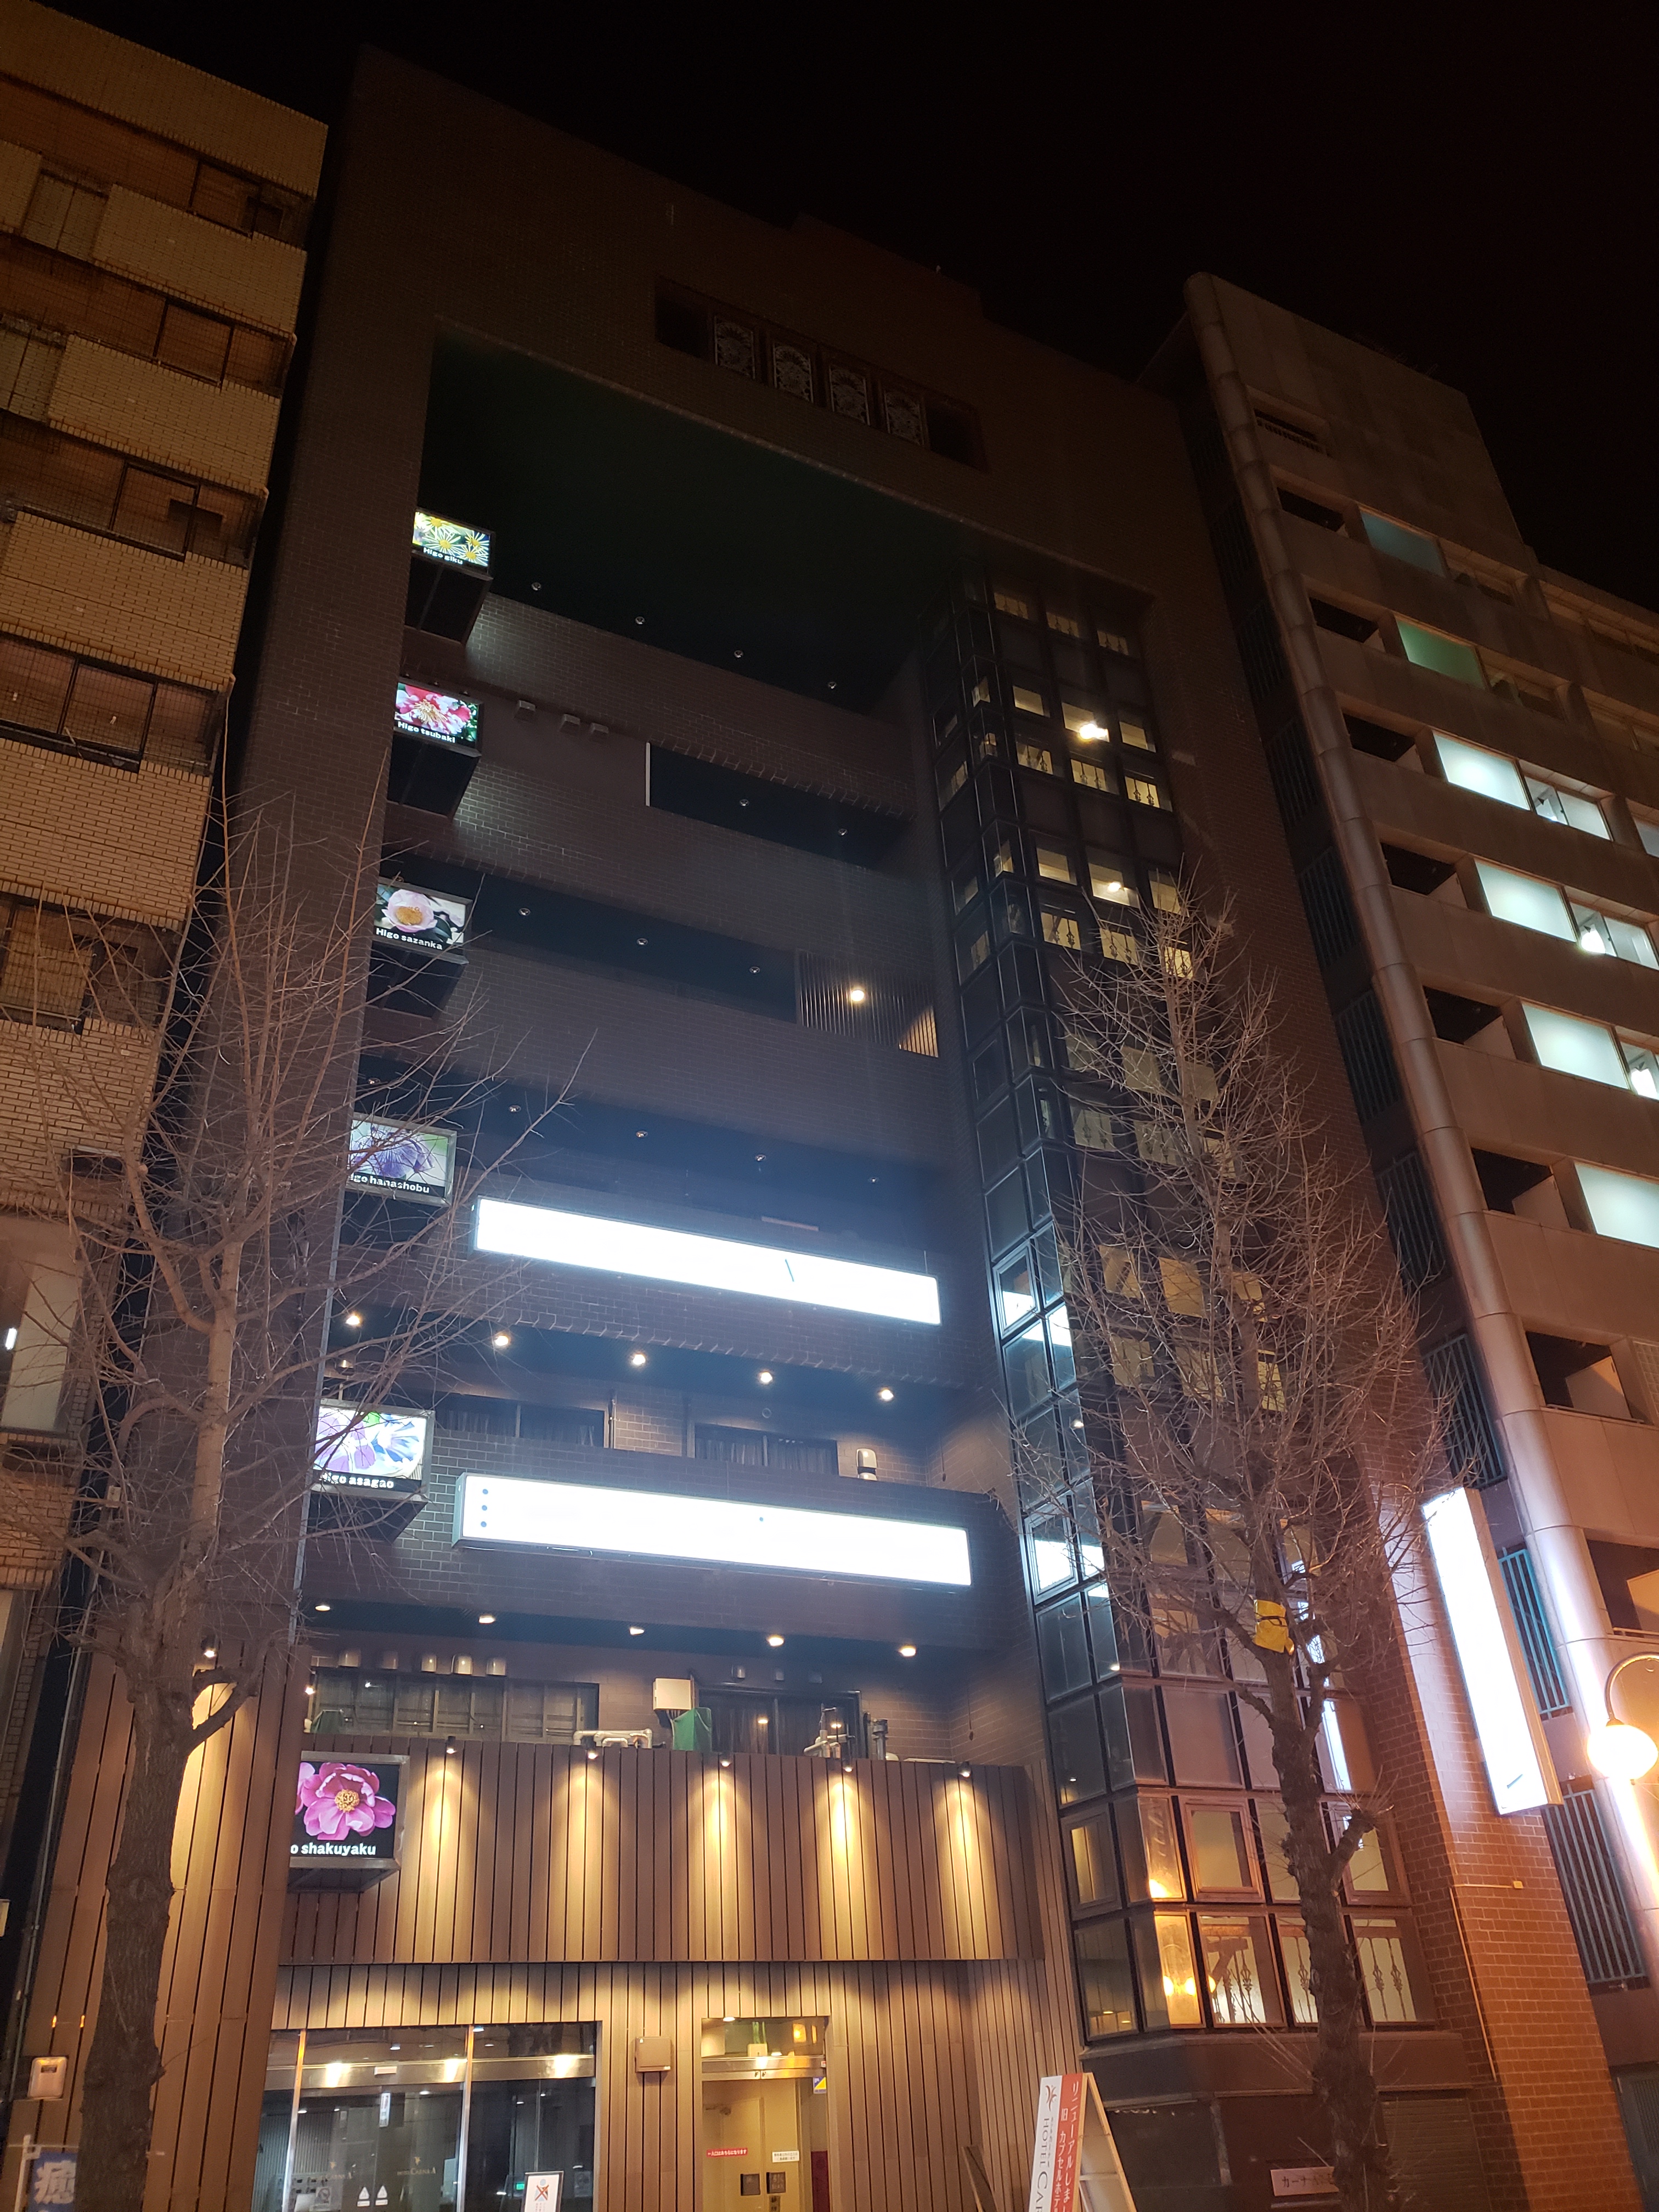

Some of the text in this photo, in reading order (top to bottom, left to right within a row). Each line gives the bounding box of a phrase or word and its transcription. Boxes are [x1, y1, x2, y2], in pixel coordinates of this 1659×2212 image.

[398, 721, 455, 743] Higo tsubaki
[376, 928, 443, 950] Higo sazanka
[348, 1477, 394, 1488] asagao
[301, 1843, 376, 1856] shakuyaku
[1040, 2118, 1049, 2168] HOTEL
[34, 2160, 76, 2212] 癒
